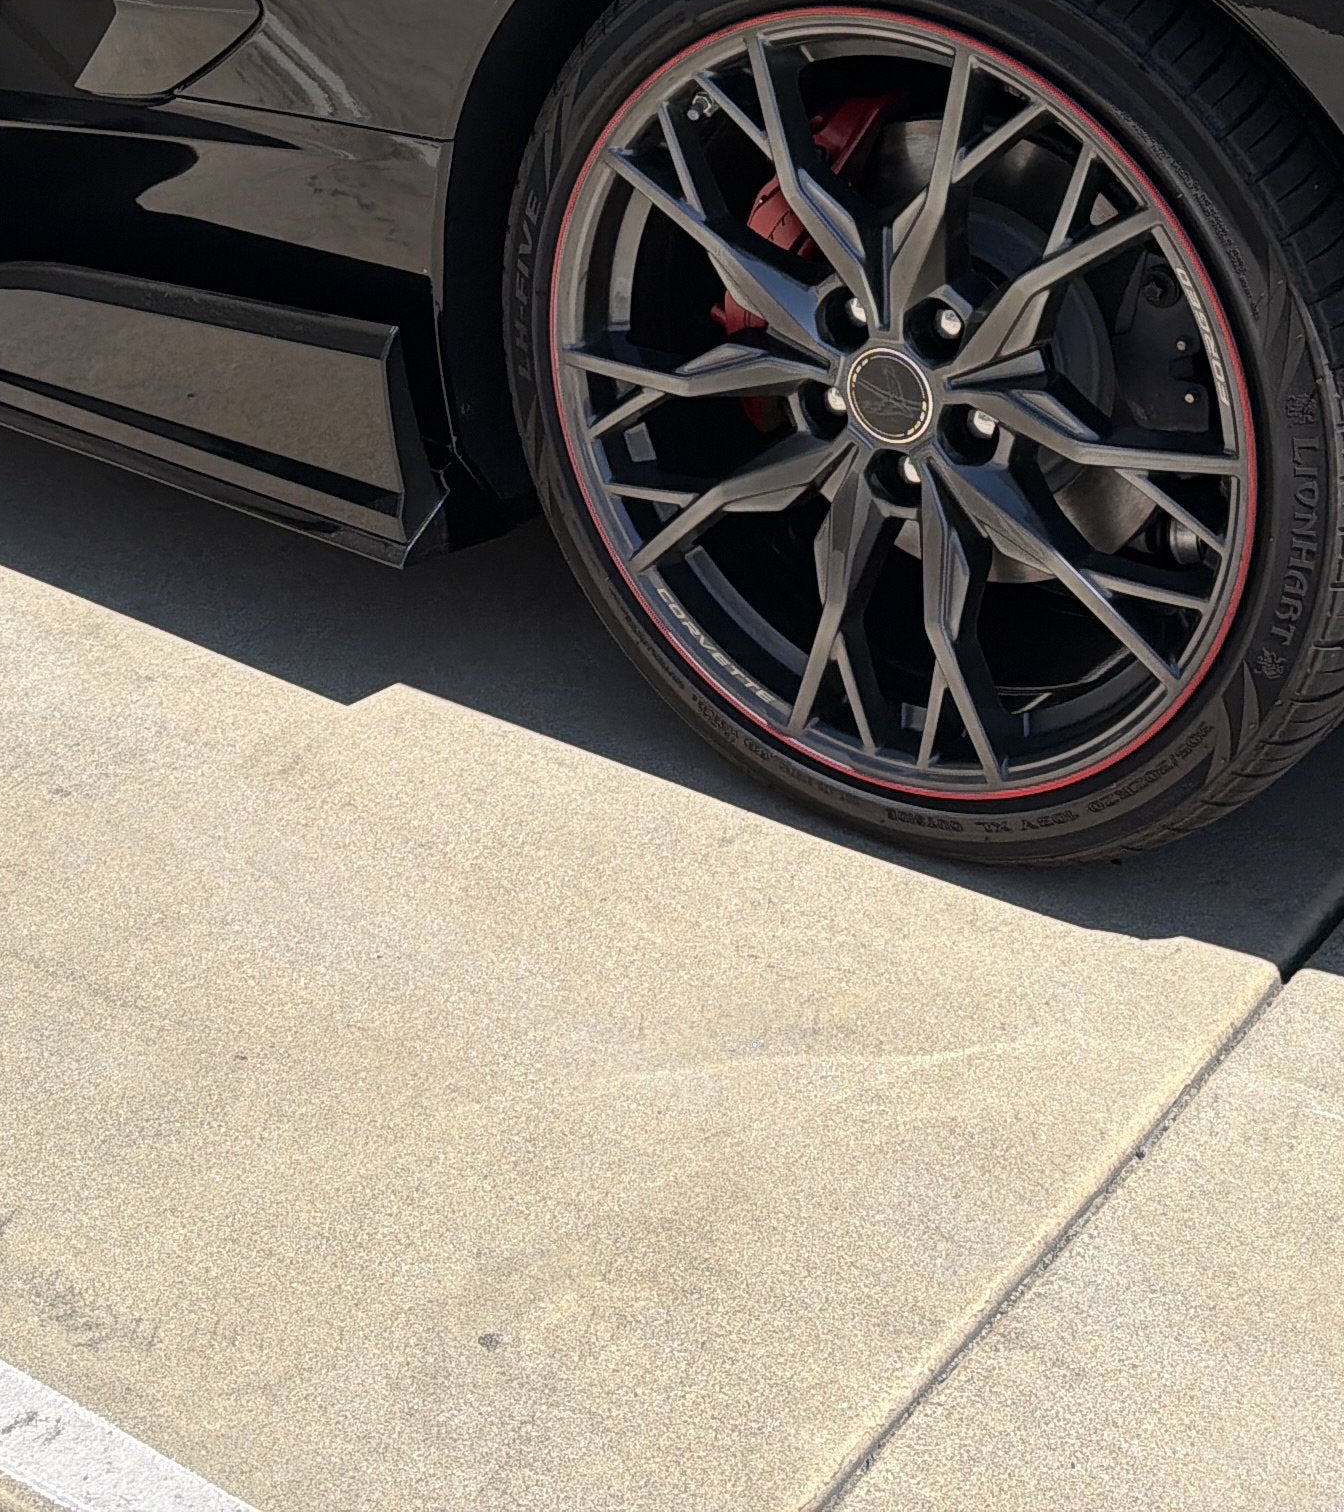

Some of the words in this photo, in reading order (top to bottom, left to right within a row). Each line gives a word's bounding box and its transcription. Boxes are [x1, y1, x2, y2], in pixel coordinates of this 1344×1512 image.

[515, 189, 542, 381] LH-FIVE
[1174, 267, 1230, 407] FORGED
[1271, 436, 1320, 646] LIONHART
[656, 588, 776, 705] CORVETTE
[975, 821, 1013, 835] XL
